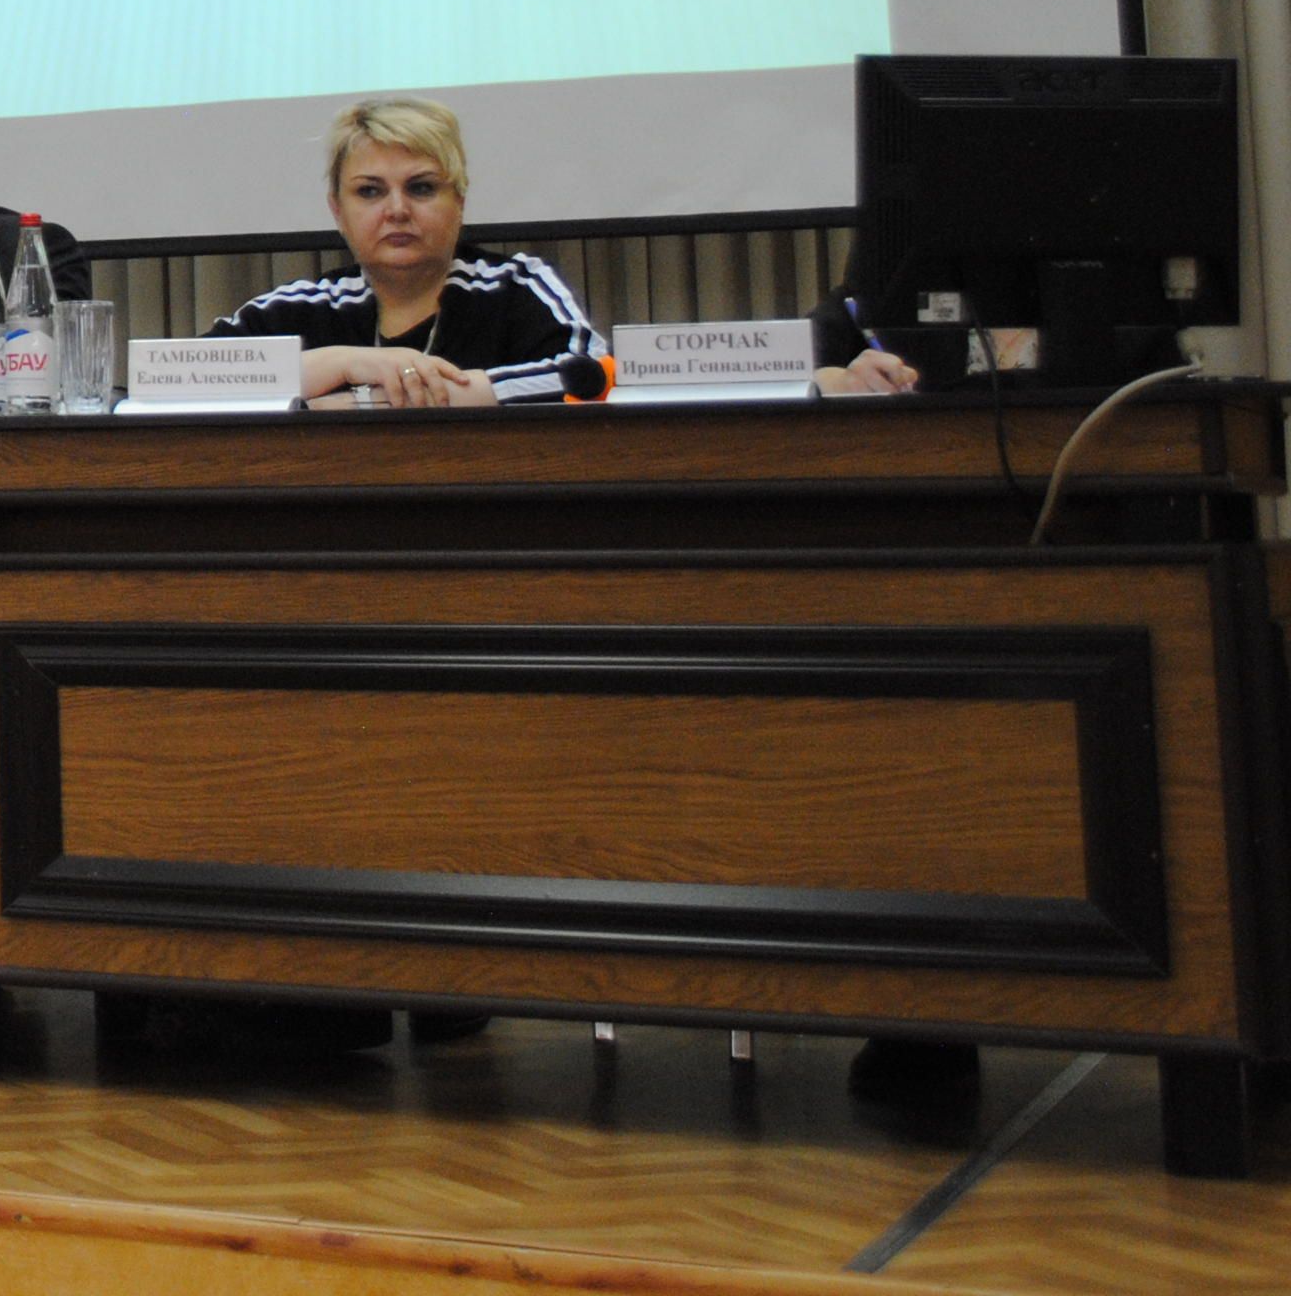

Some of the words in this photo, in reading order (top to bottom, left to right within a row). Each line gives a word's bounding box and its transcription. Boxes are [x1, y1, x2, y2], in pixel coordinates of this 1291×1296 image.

[655, 332, 769, 351] СТОРЧАК
[6, 353, 49, 371] БАУ
[146, 349, 267, 364] ТАМБОВЦЕВА
[622, 359, 681, 378] Ирина
[687, 358, 806, 374] Геннадьевна
[137, 371, 183, 385] Елена
[188, 370, 277, 385] Алексеевна
